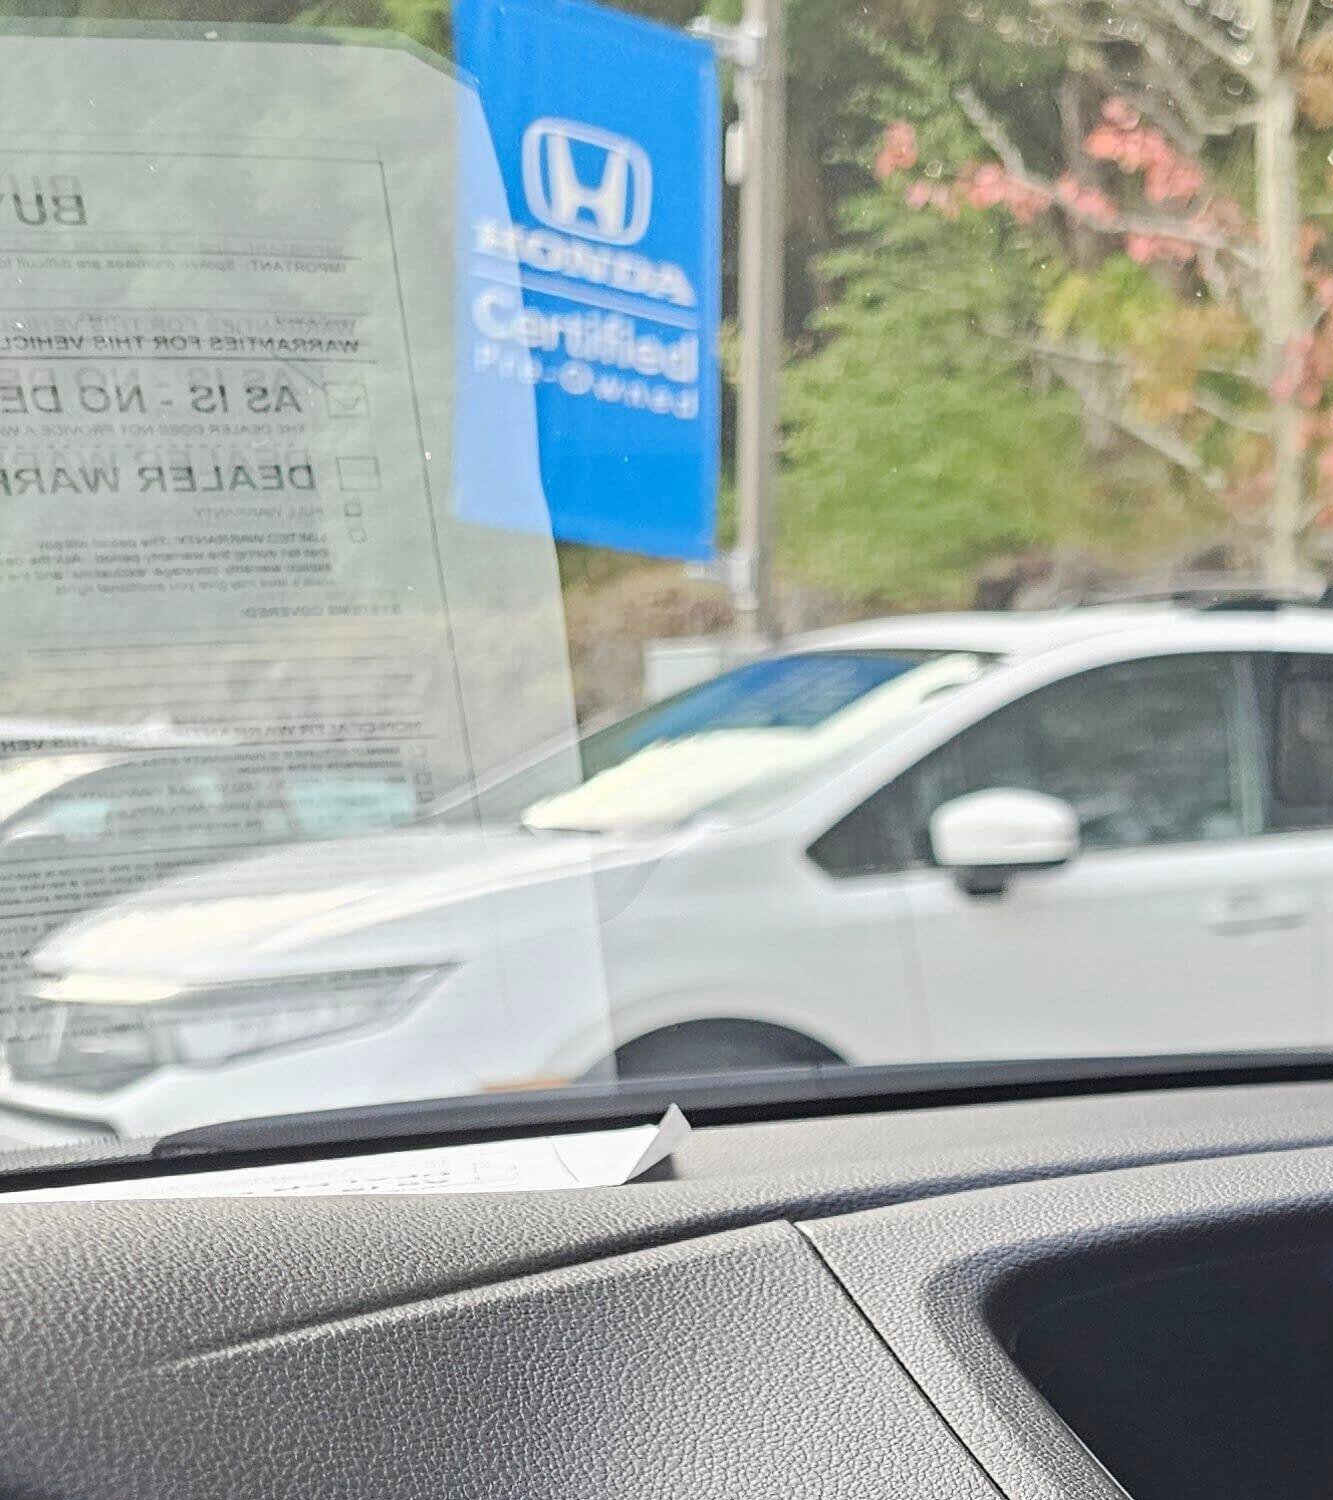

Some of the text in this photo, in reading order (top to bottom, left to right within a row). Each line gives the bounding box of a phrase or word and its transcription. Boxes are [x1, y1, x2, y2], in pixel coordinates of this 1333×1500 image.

[474, 220, 696, 308] HONDA
[473, 286, 699, 384] Certified
[474, 341, 699, 420] Pre-Owned
